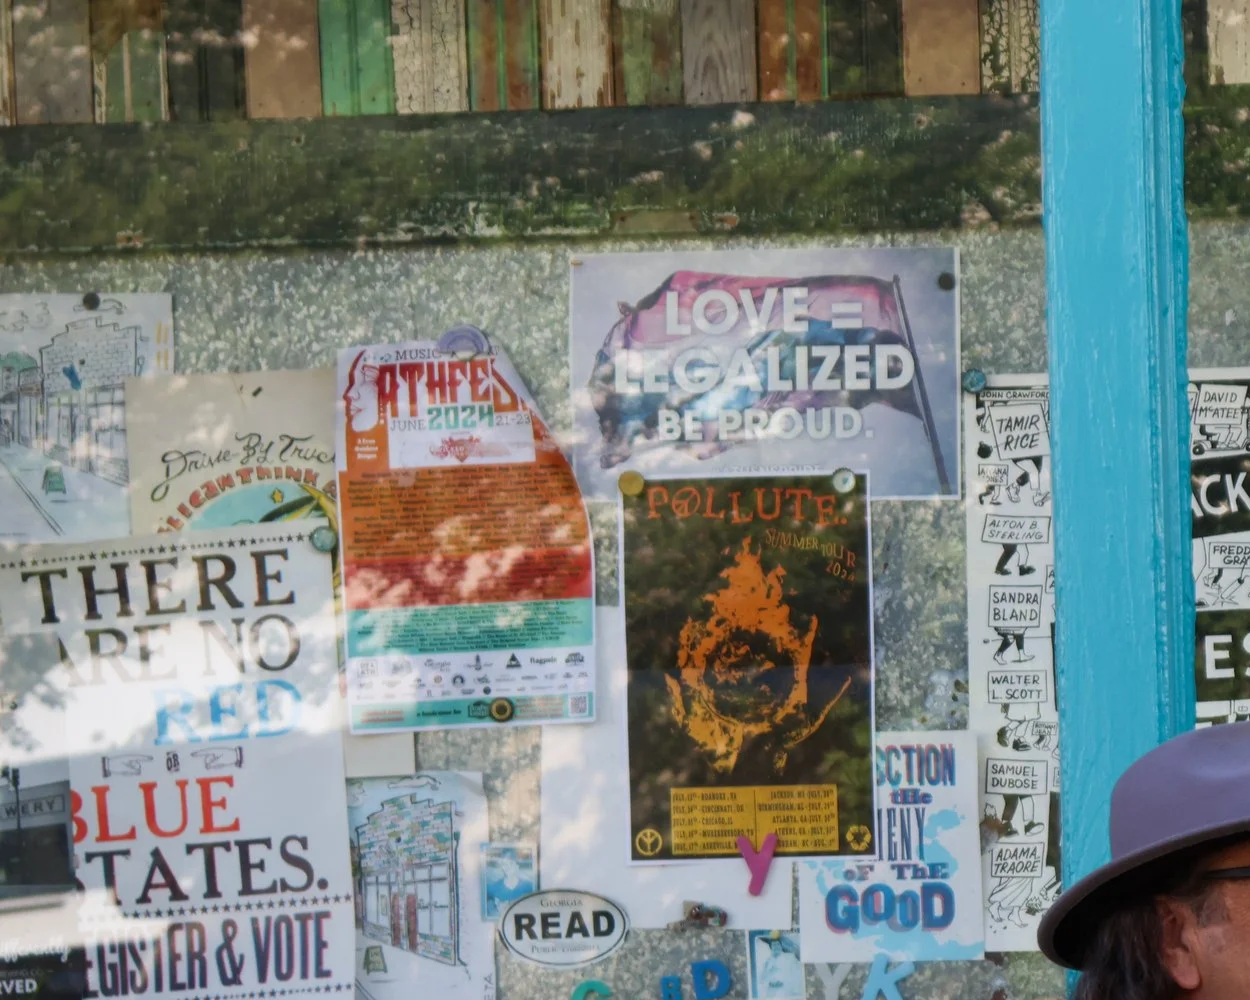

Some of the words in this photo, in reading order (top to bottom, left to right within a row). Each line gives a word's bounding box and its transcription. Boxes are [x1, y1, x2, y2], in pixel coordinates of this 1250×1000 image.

[665, 286, 810, 336] LOVE
[613, 343, 916, 394] LEGALIZED
[980, 389, 1004, 399] JOHN
[1203, 391, 1238, 404] DAVID
[389, 418, 427, 432] JUNE
[426, 404, 495, 431] 2024
[657, 409, 705, 443] BE
[718, 405, 875, 441] PROUD.
[995, 414, 1041, 434] TAMIR
[279, 434, 335, 463] Truc
[1004, 433, 1040, 451] RICE
[988, 520, 1026, 530] ALTON
[988, 530, 1044, 541] STERLING
[765, 527, 819, 550] SUMMER
[820, 543, 857, 568] TOUR
[21, 547, 297, 625] THERE
[992, 591, 1040, 605] SANDRA
[993, 606, 1039, 622] BLAND
[198, 613, 301, 677] NO
[991, 674, 1040, 686] WALTER
[1005, 688, 1043, 700] SCOTT
[154, 679, 302, 745] RED
[166, 753, 180, 772] OR
[991, 763, 1038, 777] SAMUEL
[991, 777, 1038, 790] DUBOSE
[70, 775, 241, 844] BLUE
[734, 833, 778, 896] Y
[995, 846, 1040, 861] ADAMA
[75, 834, 329, 907] TATES.
[825, 881, 957, 935] GOOD
[514, 910, 615, 941] READ
[81, 920, 208, 1000] EGISTER
[216, 918, 245, 987] &
[251, 910, 332, 986] VOTE
[0, 977, 39, 995] VED
[691, 959, 731, 1000] D
